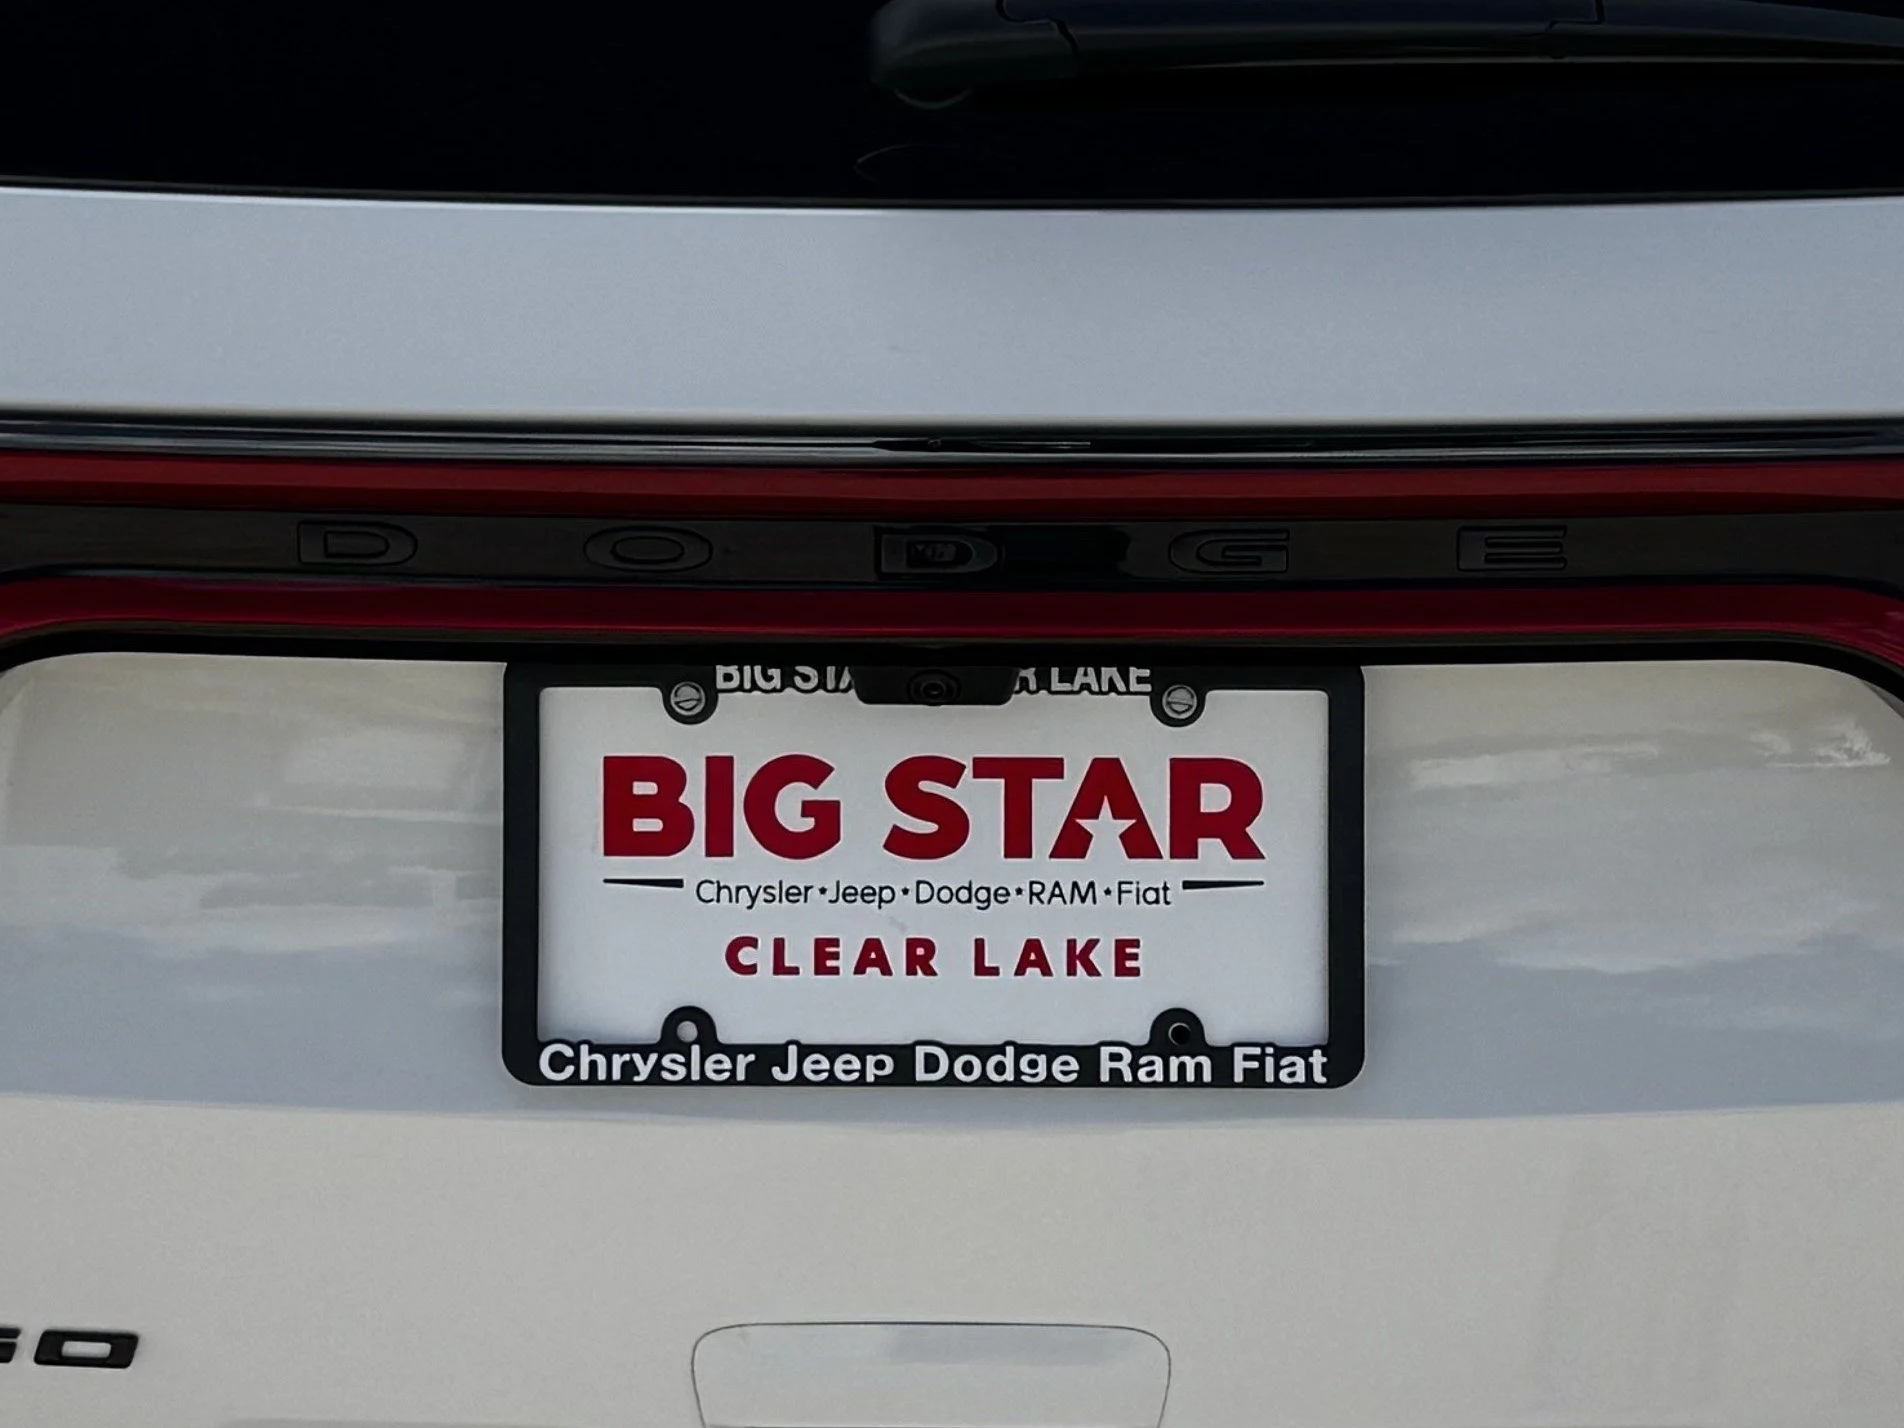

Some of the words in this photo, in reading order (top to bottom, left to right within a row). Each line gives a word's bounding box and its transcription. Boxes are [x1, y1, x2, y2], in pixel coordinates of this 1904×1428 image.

[296, 517, 1570, 575] DODGE
[1051, 667, 1152, 692] LAKE
[603, 754, 842, 862] BIG
[882, 755, 1266, 861] STAR
[695, 879, 812, 910] Chrysler
[827, 879, 897, 910] Jeep
[915, 879, 1012, 911] Dodge
[1028, 881, 1098, 906] RAM
[1118, 881, 1172, 907] Fiat
[725, 936, 938, 978] CLEAR
[974, 938, 1141, 978] LAKE
[538, 1043, 756, 1084] Chrysler
[771, 1044, 896, 1084] Jeep
[914, 1044, 1081, 1084] Dodge
[1099, 1045, 1214, 1084] Ram
[1233, 1045, 1330, 1084] Fiat
